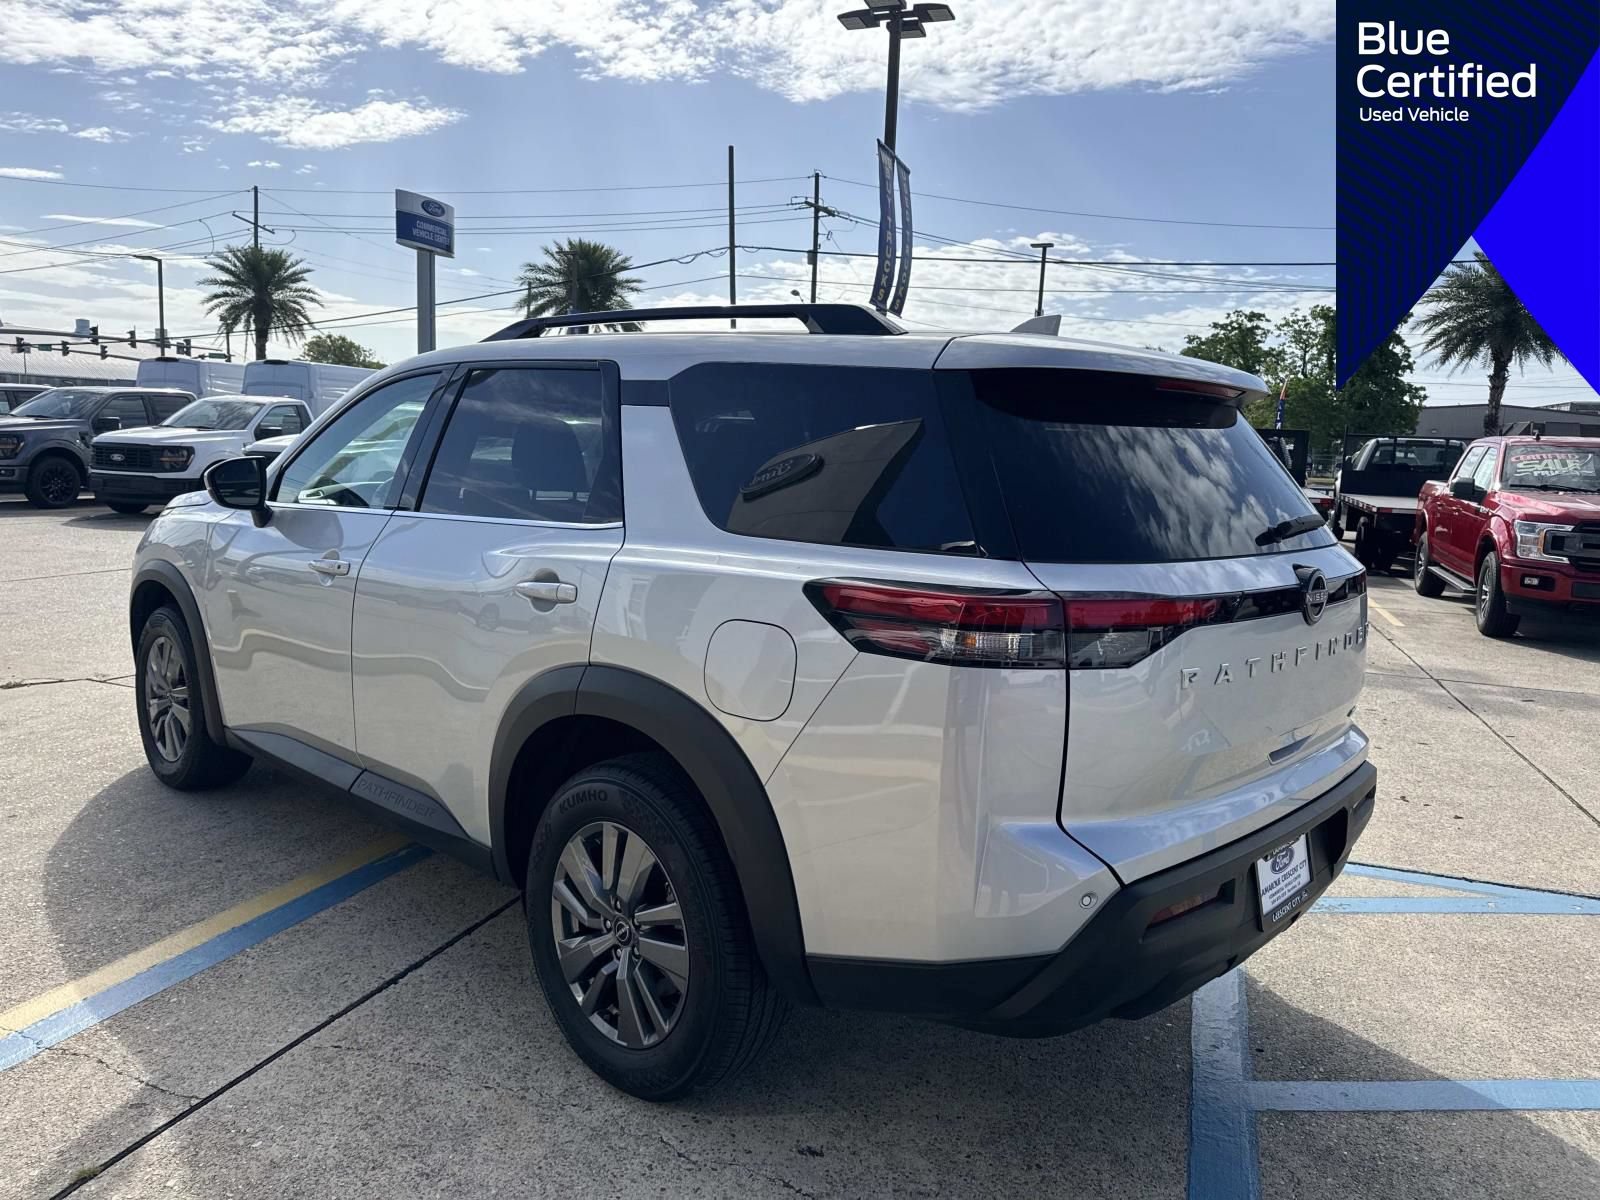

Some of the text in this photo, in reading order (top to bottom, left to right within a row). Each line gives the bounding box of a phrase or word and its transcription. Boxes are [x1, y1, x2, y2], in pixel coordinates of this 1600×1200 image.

[411, 227, 434, 241] VEHICLE
[877, 216, 893, 301] TRUCKS
[894, 230, 910, 310] TRUCKS
[1516, 459, 1581, 473] SALE
[357, 779, 436, 818] PATHFINDER
[559, 789, 608, 814] KUMHO
[1281, 864, 1299, 882] CRESCENT
[1272, 901, 1292, 922] CRESCENT
